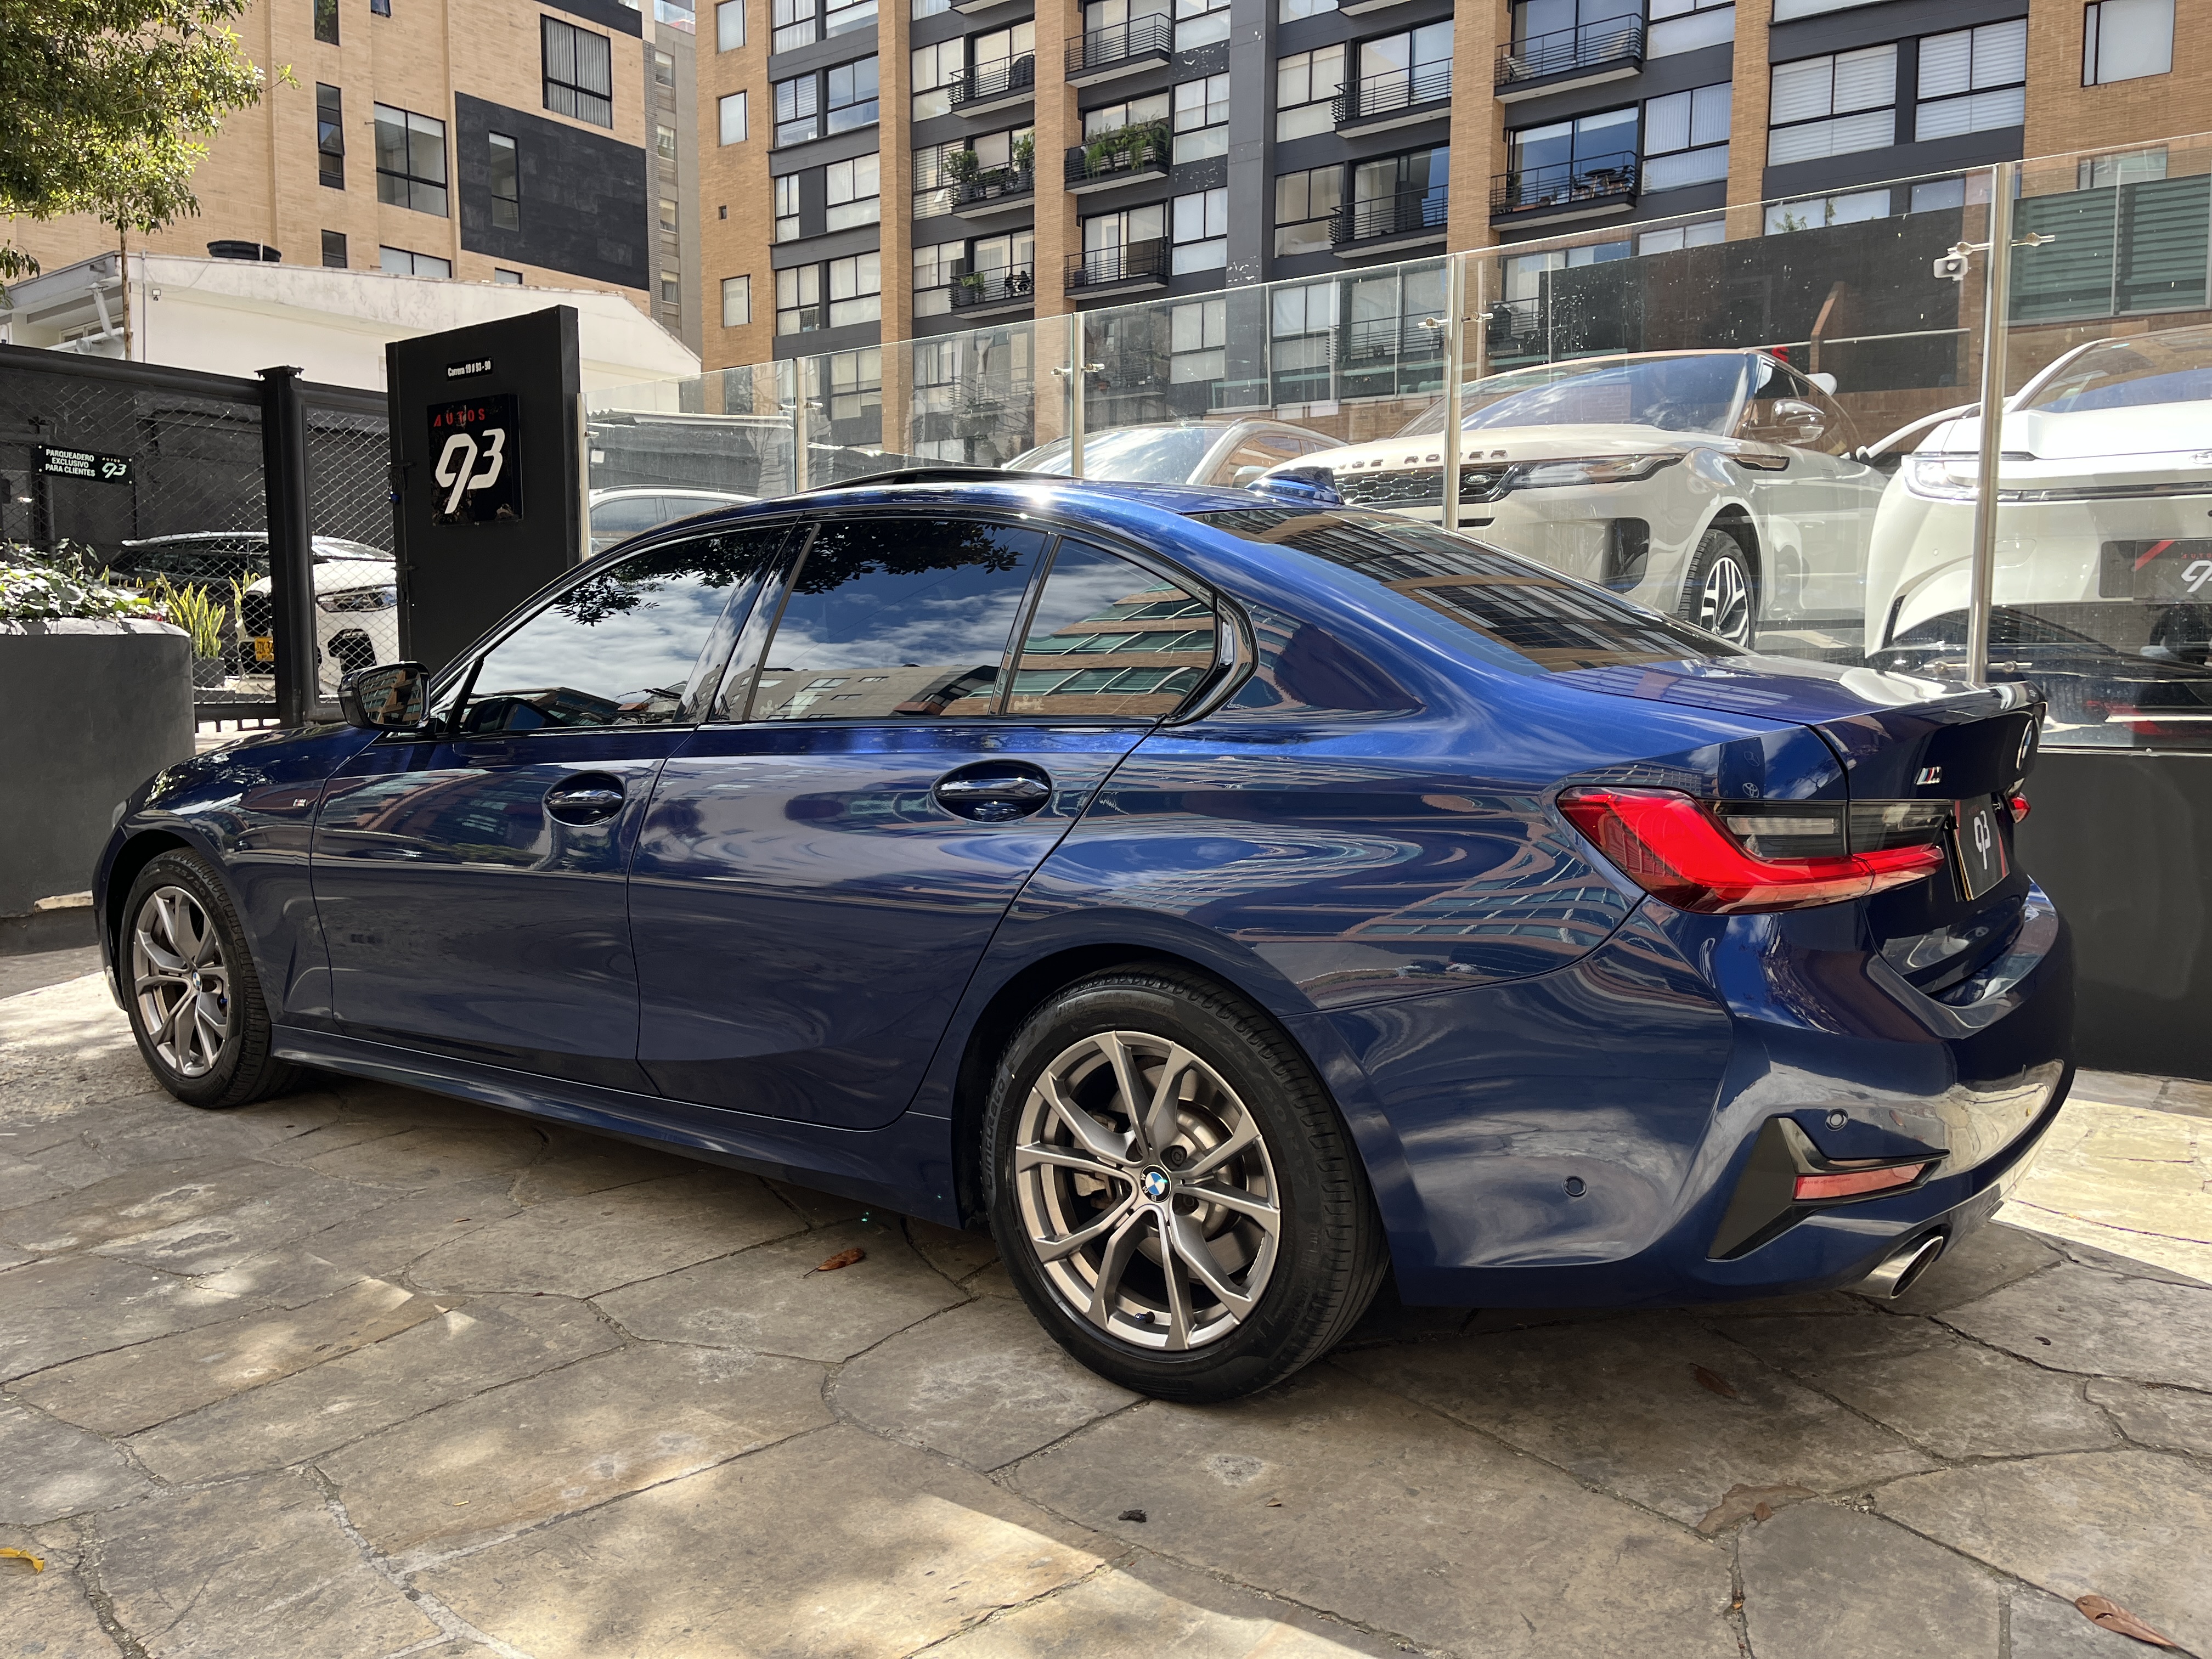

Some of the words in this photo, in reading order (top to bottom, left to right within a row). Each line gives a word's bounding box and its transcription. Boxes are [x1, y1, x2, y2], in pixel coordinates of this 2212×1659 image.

[448, 367, 465, 377] Carrera
[465, 364, 471, 374] 19
[433, 408, 486, 427] AUTOS
[46, 448, 94, 462] PARQUEADERO
[1404, 449, 1508, 464] ROER
[52, 457, 89, 468] EXCLUSIVO
[45, 464, 63, 473] PARA
[64, 466, 95, 477] CLIENTES
[101, 462, 127, 478] 93
[435, 428, 505, 514] 93
